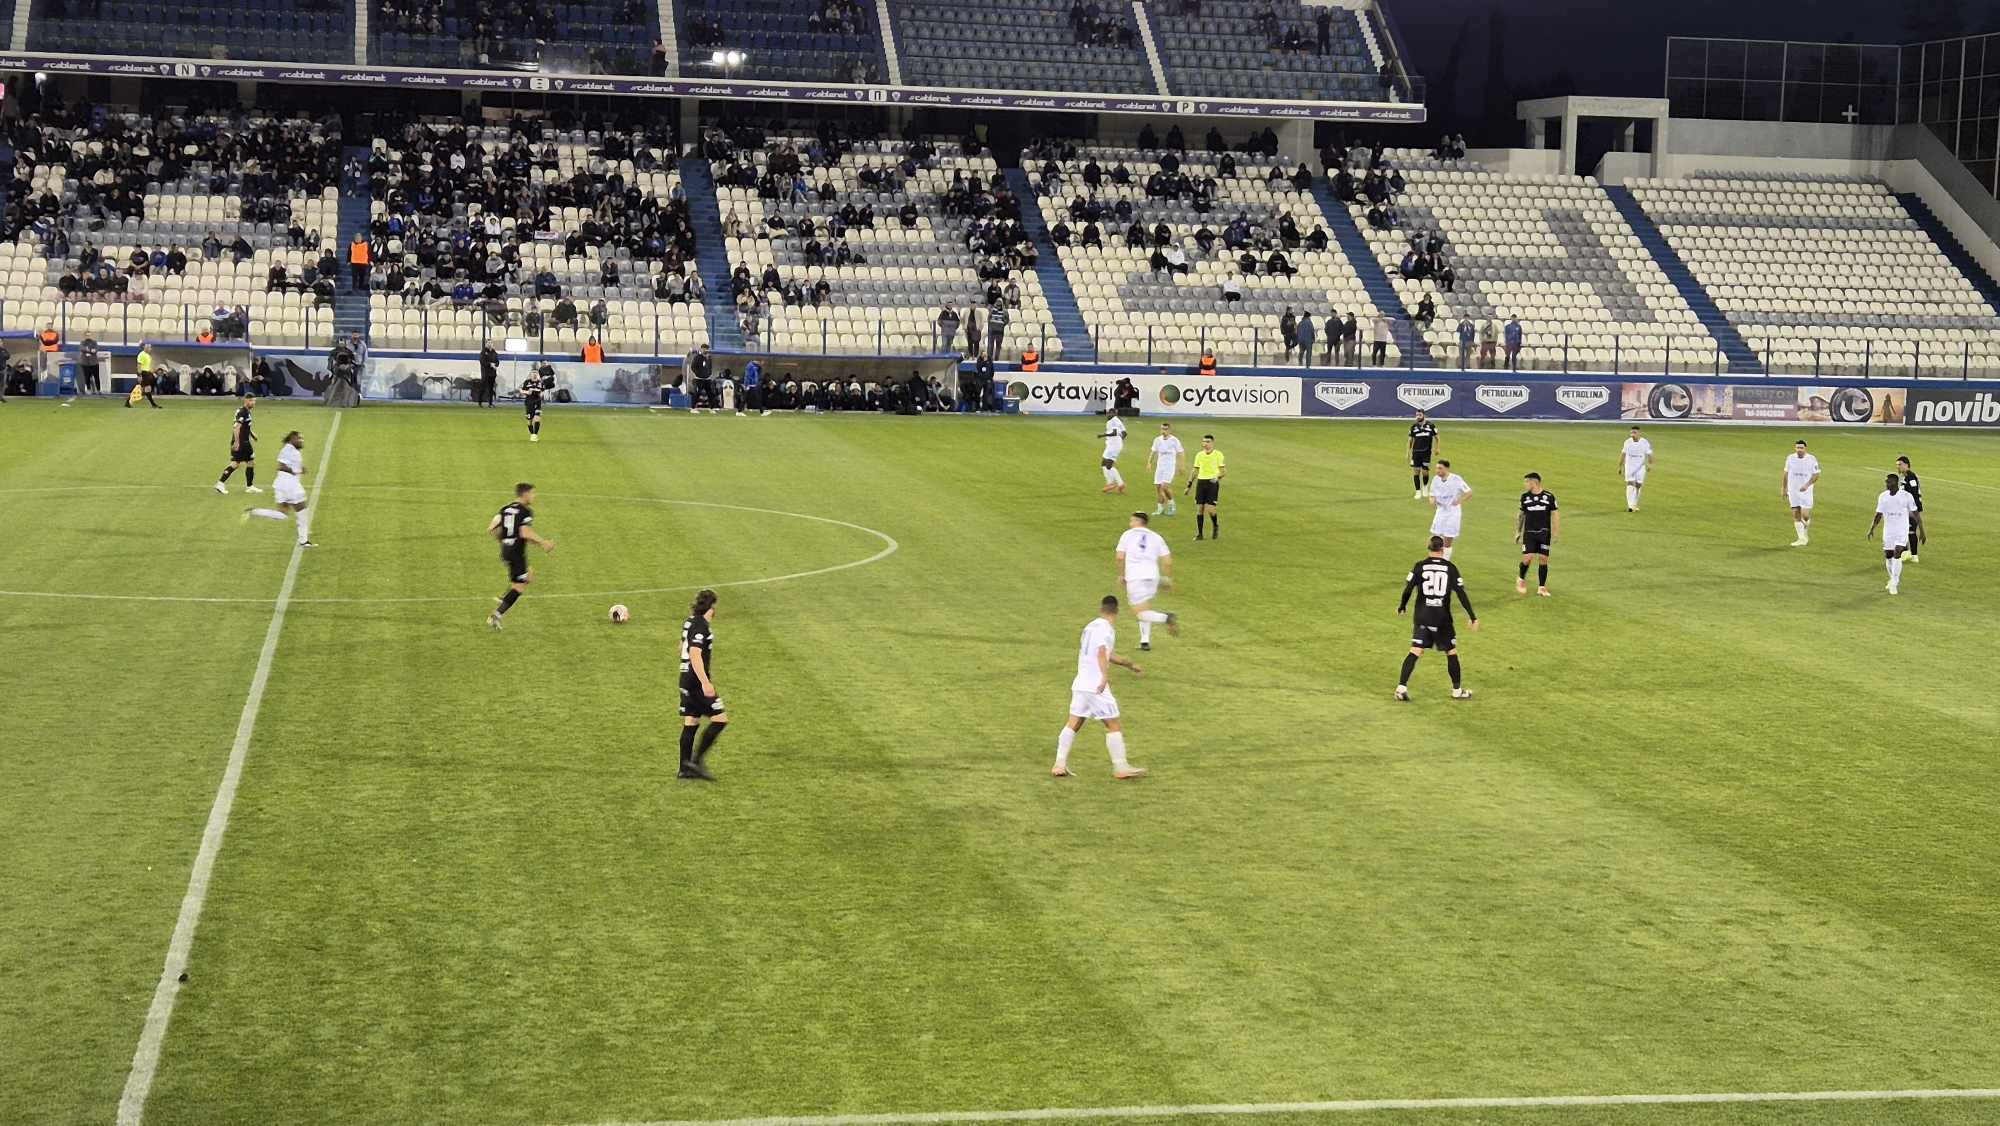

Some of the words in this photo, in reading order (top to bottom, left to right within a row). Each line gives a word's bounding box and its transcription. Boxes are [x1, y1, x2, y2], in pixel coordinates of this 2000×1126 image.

[180, 64, 190, 74] N
[1182, 382, 1289, 406] cytavision
[1321, 386, 1364, 396] PETROLINA
[1403, 387, 1446, 397] PETROLINA
[1481, 388, 1523, 398] PETROLINA
[1562, 390, 1604, 399] PETROLINA
[1422, 570, 1448, 597] 20
